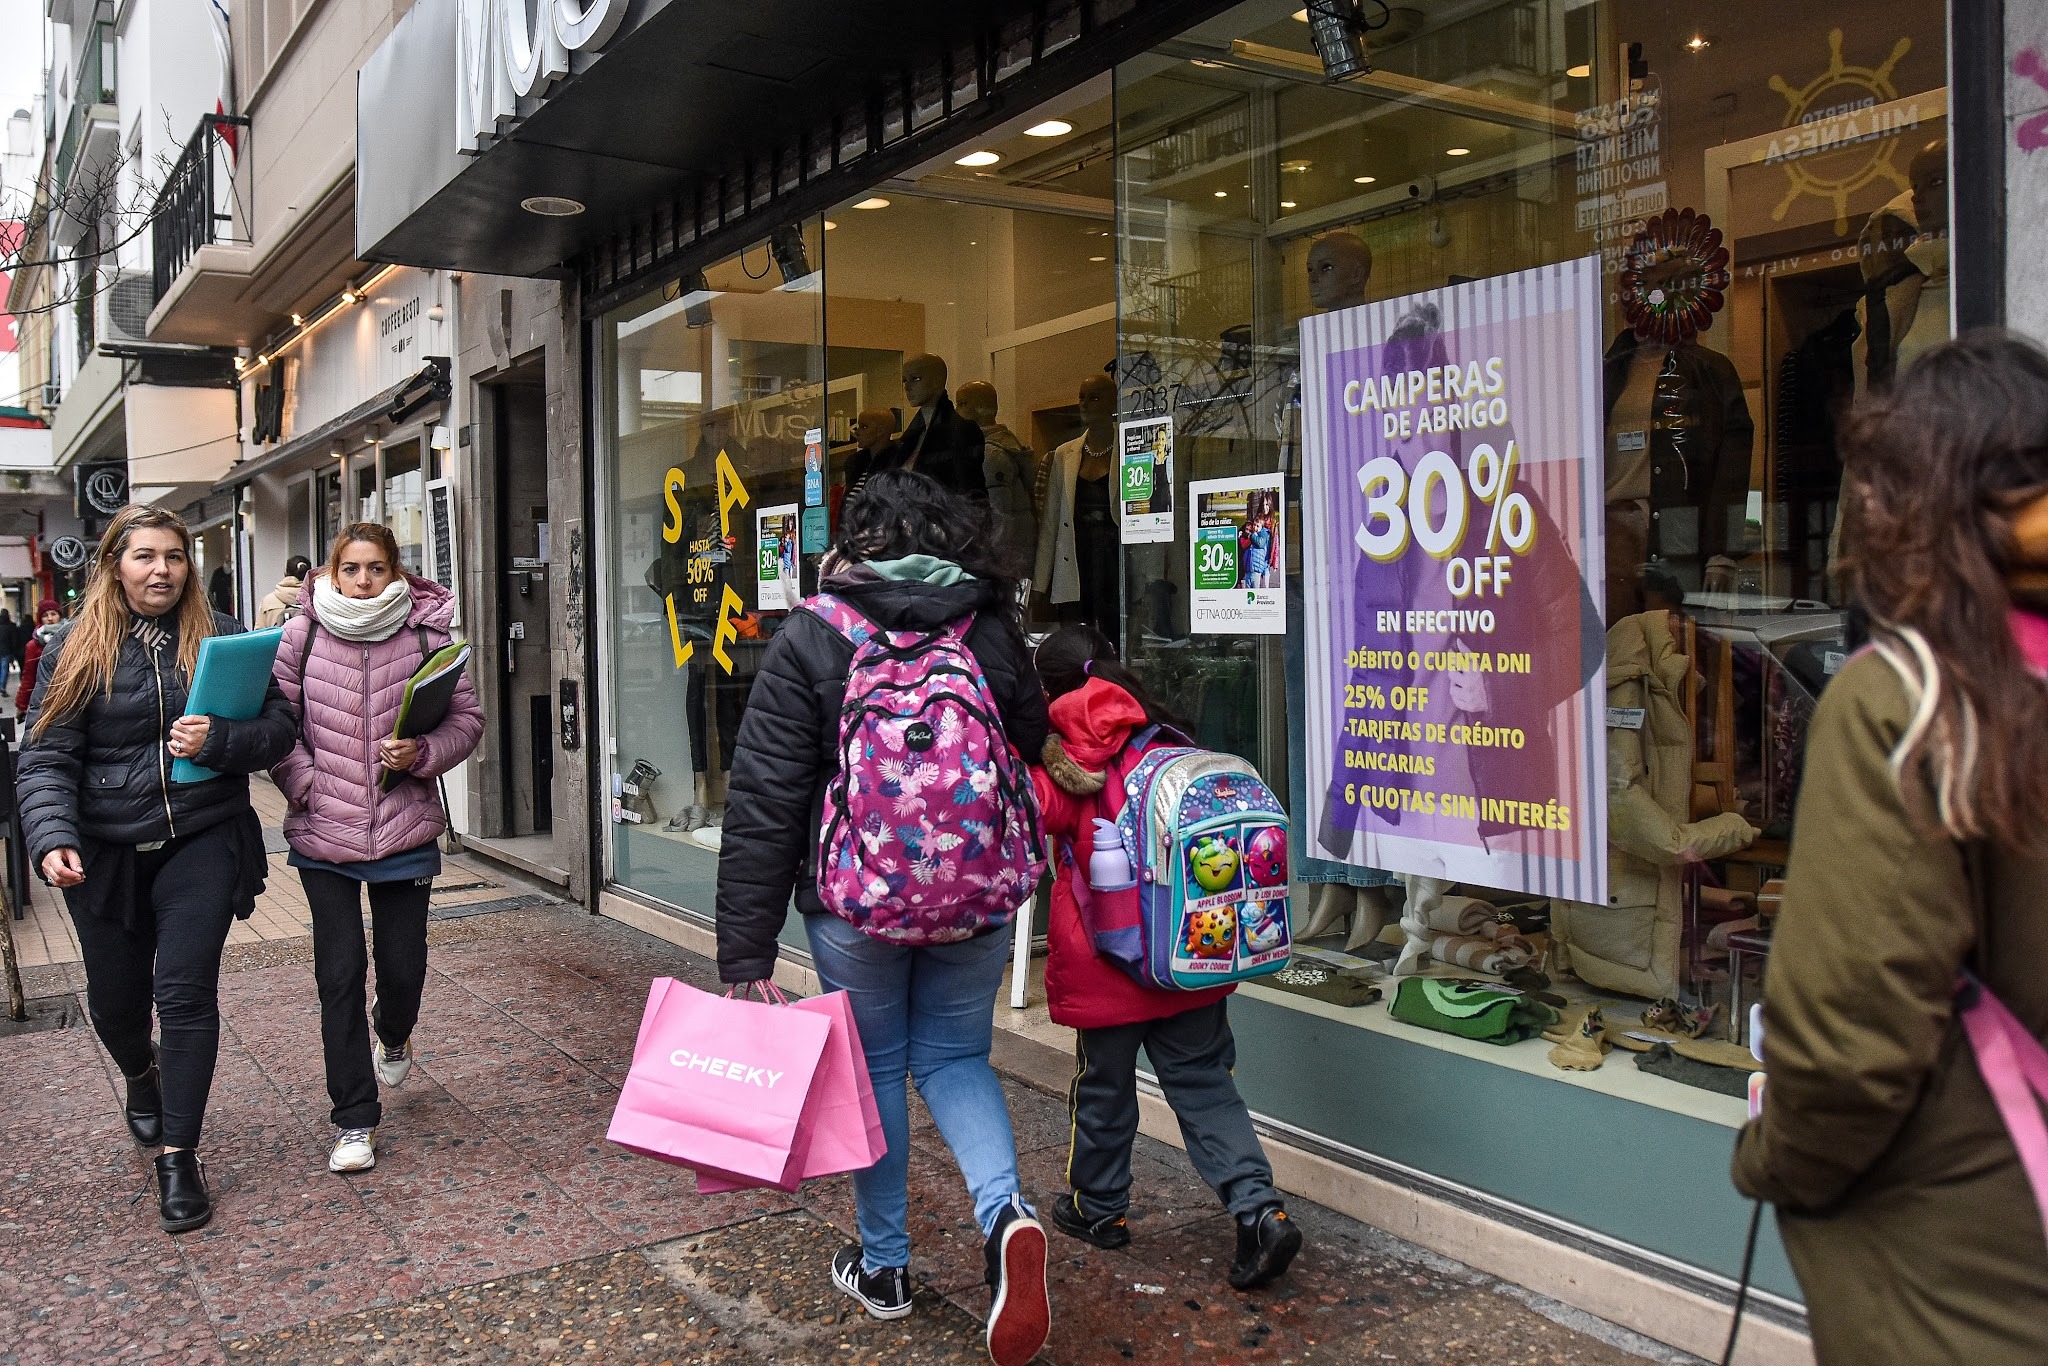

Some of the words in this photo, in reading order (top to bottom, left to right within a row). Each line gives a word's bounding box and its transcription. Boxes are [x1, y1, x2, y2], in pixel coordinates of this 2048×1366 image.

[1343, 356, 1504, 415] CAMPERAS
[1383, 410, 1411, 439] DE
[1416, 397, 1508, 436] ABRIGO
[1127, 466, 1150, 488] 30%
[1355, 440, 1538, 564] 30%
[689, 539, 710, 554] HASTA
[1198, 543, 1234, 572] 30%
[687, 557, 714, 585] 50%
[1446, 555, 1512, 599] OFF
[693, 588, 708, 603] OFF
[1376, 610, 1401, 634] EN
[1405, 609, 1496, 634] EFECTIVO
[1407, 651, 1420, 670] O
[1424, 651, 1493, 673] CUENTA
[1496, 652, 1531, 674] DNI
[1343, 684, 1386, 711] 25%
[1390, 685, 1429, 712] OFF
[1425, 723, 1446, 744] DE
[1450, 720, 1526, 750] CRÉDITO
[1344, 749, 1436, 776] BANCARIAS
[1344, 783, 1356, 805] 6
[1359, 784, 1436, 815] CUOTAS
[1440, 793, 1476, 820] SIN
[1480, 798, 1572, 832] INTERÉS
[1196, 896, 1216, 909] APPLE
[1216, 891, 1243, 907] BLOSSOM
[1189, 962, 1209, 971] KOOKY
[1209, 962, 1231, 971] COOKIE
[1251, 953, 1272, 966] SNEAKY
[1272, 948, 1290, 960] WEDGE
[669, 1049, 784, 1089] CHEEKY
